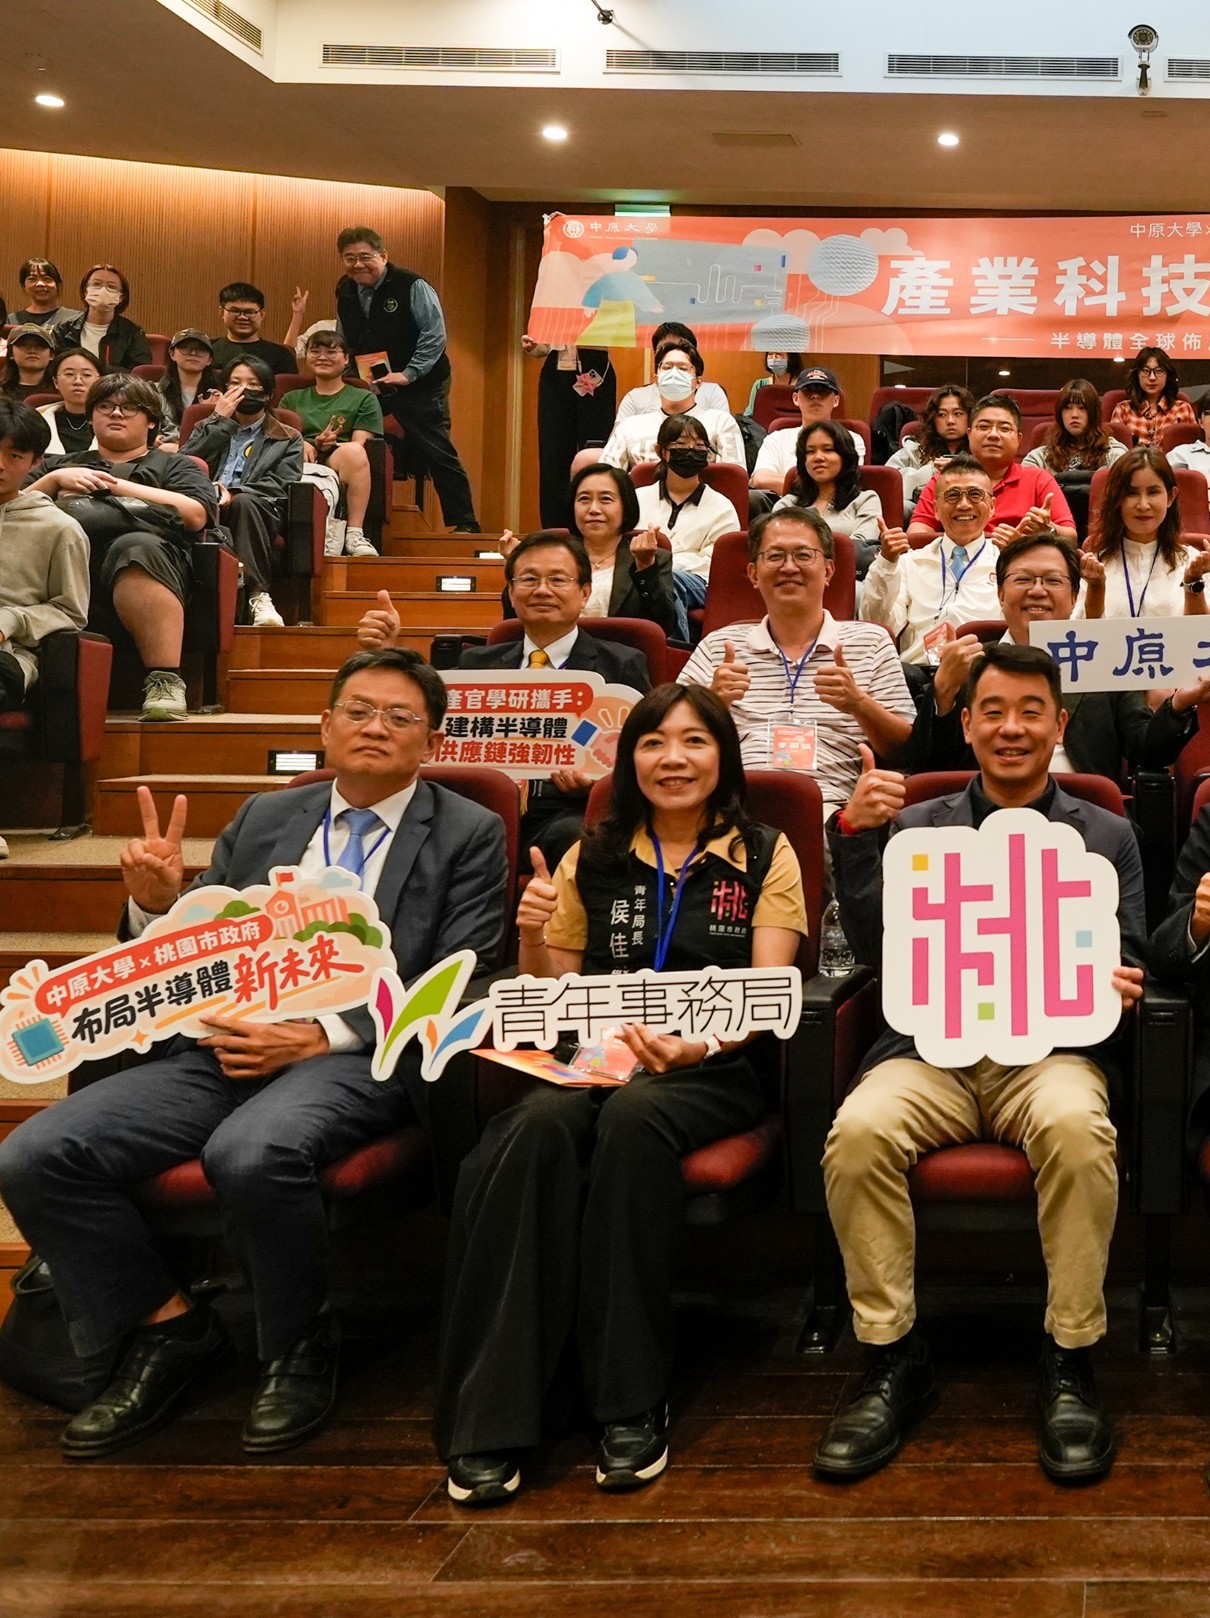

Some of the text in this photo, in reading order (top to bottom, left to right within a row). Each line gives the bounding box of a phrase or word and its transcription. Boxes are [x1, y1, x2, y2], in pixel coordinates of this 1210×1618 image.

[445, 716, 568, 739] 建構半導體
[435, 740, 576, 765] 供應鏈強韌性
[631, 885, 647, 946] 青年局長
[496, 975, 793, 1043] 青年事務局
